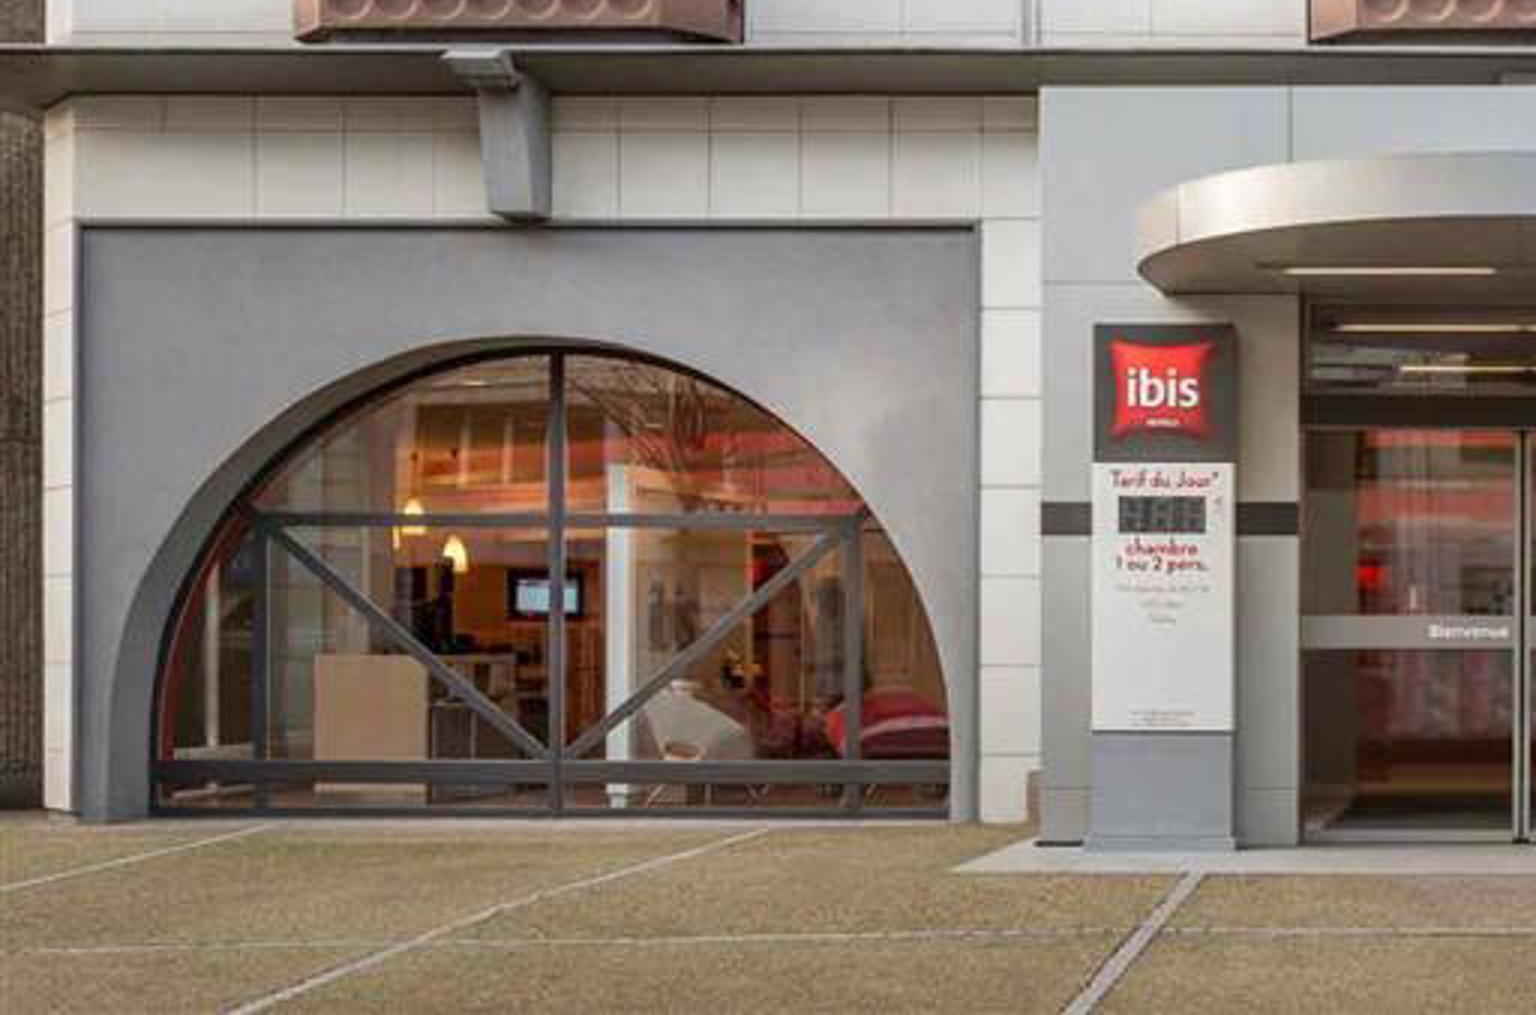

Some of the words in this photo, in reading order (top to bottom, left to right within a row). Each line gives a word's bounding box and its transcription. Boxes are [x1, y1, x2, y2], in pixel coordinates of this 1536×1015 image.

[1127, 366, 1200, 407] ibis
[1125, 537, 1198, 556] chambre
[1127, 561, 1149, 572] ou
[1152, 555, 1162, 572] 2
[1428, 624, 1509, 639] Bienvenue
